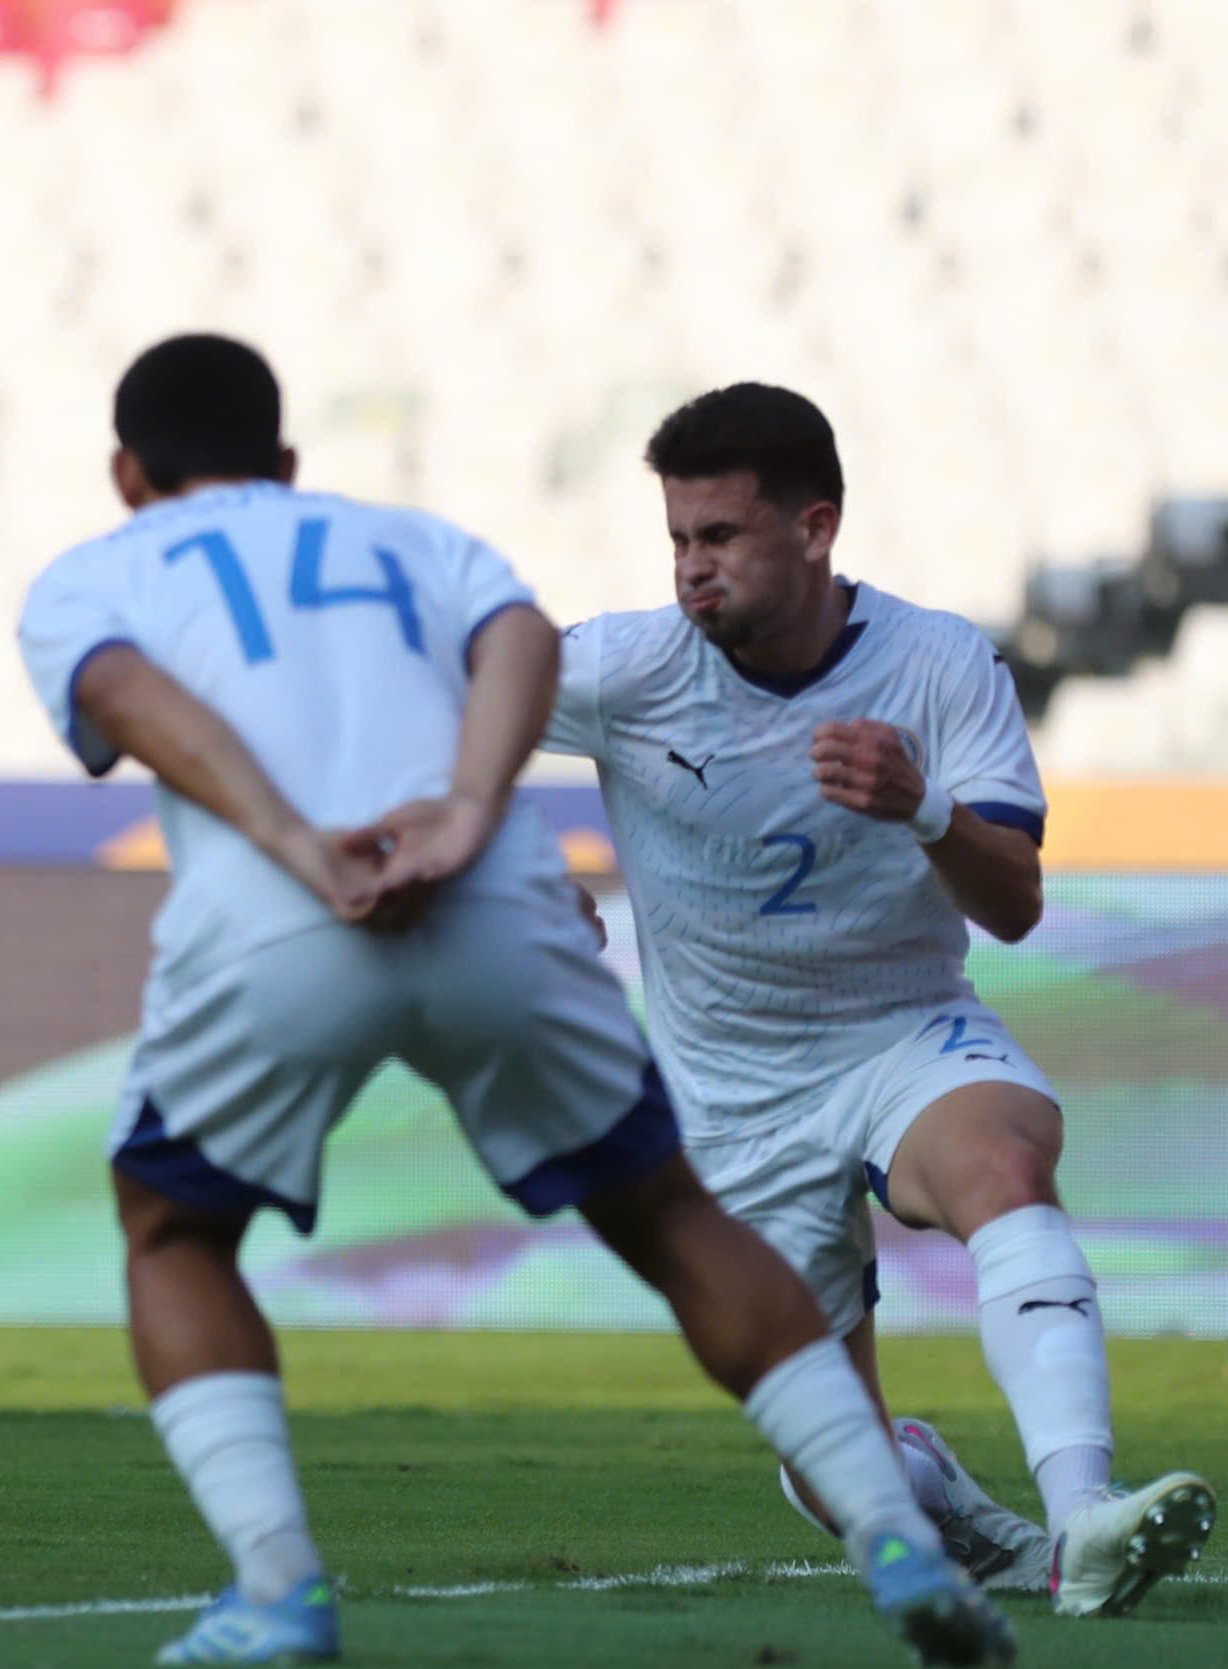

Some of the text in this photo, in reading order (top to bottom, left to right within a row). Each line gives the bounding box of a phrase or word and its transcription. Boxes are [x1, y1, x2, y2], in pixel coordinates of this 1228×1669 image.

[164, 518, 426, 665] 14
[758, 833, 817, 915] 2
[916, 1015, 992, 1055] 2
